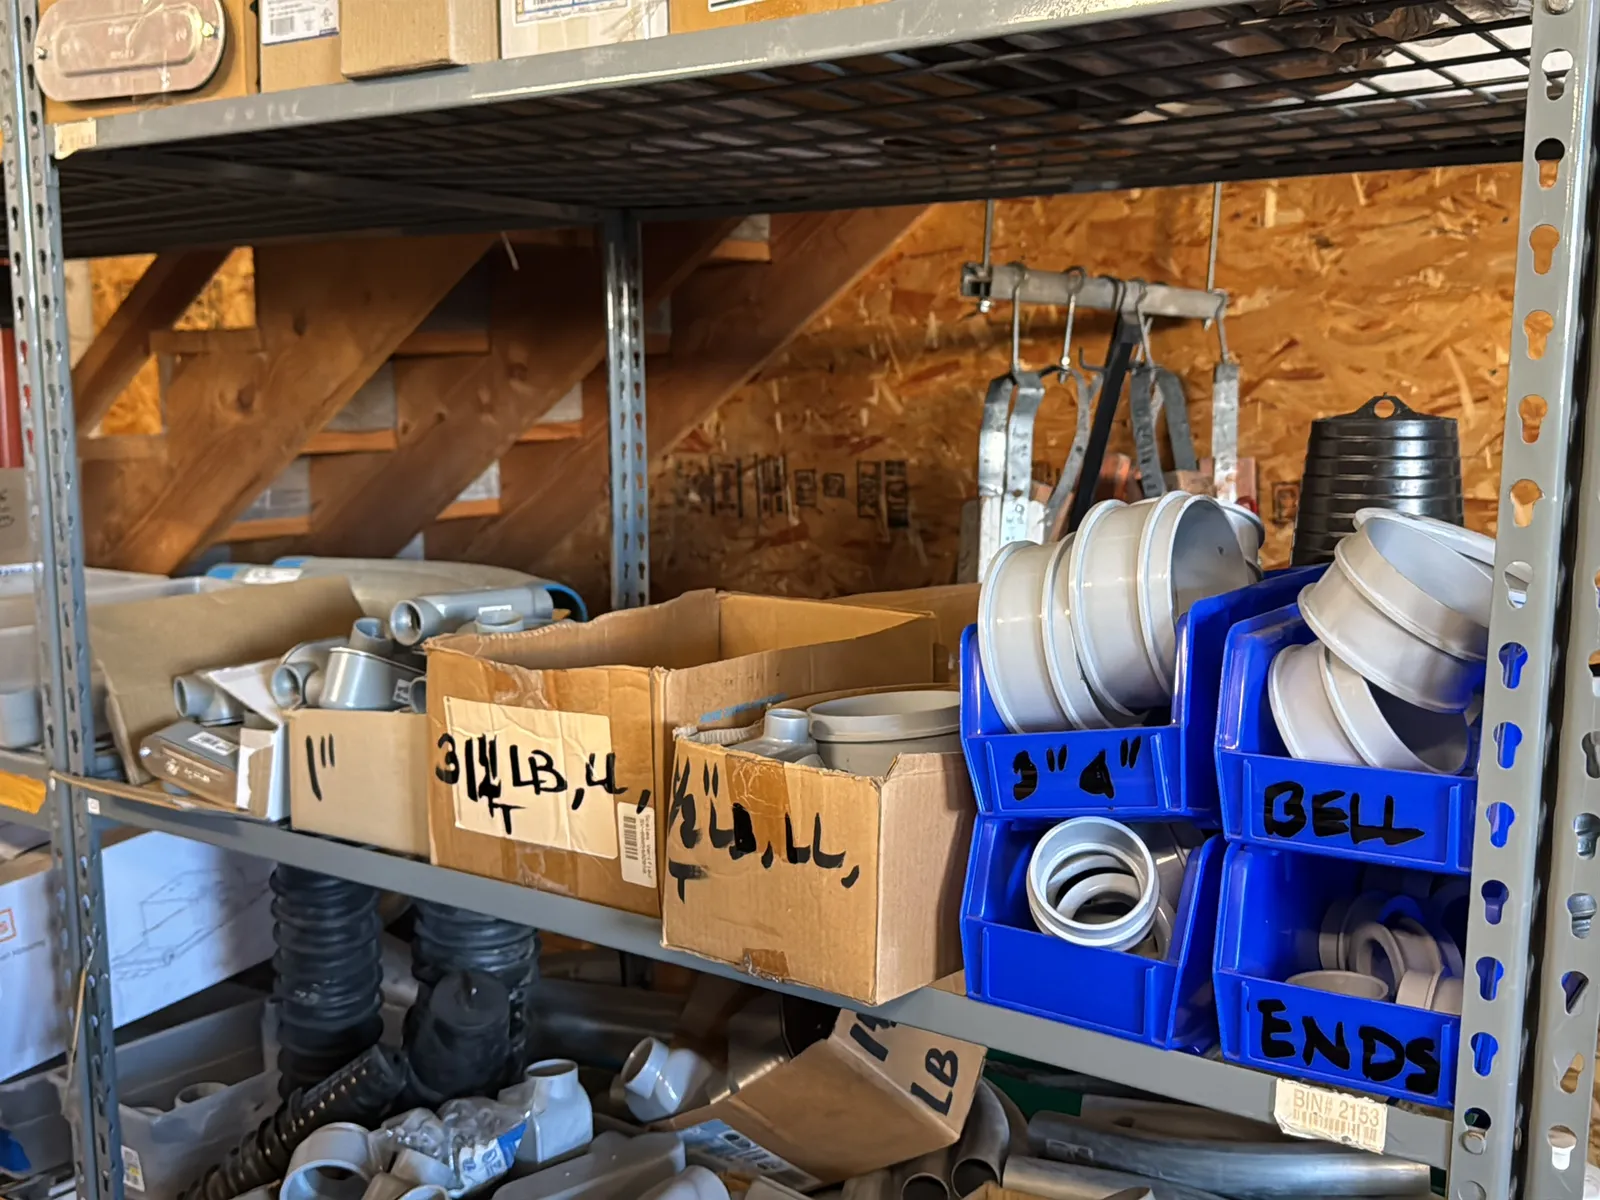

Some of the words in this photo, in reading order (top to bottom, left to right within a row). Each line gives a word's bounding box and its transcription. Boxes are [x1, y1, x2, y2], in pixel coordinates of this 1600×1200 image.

[1263, 780, 1425, 847] BELL
[1256, 998, 1441, 1095] ENDS
[910, 1047, 959, 1117] LB
[1293, 1088, 1334, 1117] BIN#
[1338, 1099, 1381, 1128] 2153
